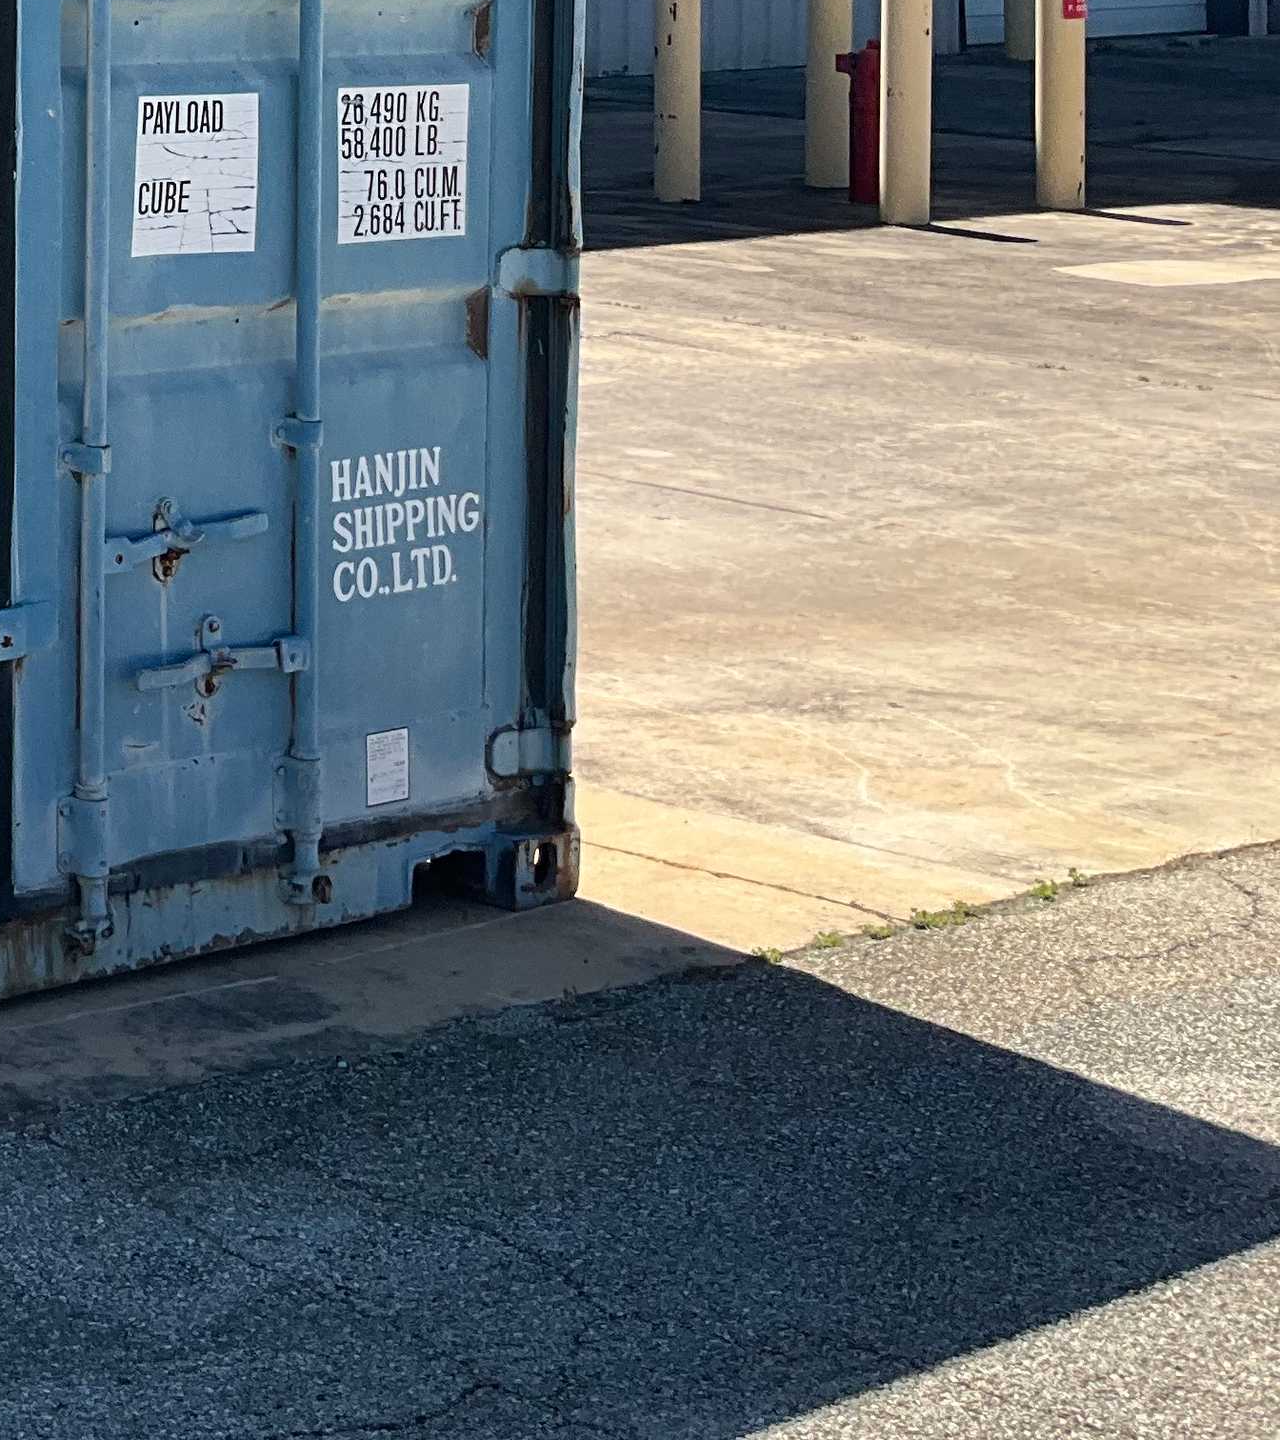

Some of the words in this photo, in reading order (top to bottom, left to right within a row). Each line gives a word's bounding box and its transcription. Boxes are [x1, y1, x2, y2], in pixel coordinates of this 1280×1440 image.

[141, 100, 224, 134] PAYLOAD
[416, 91, 444, 122] KG.
[341, 125, 406, 159] 58,400
[415, 124, 443, 156] LB.
[138, 179, 191, 216] CUBE
[364, 168, 406, 201] 76.0
[354, 202, 406, 236] 2,684
[330, 446, 442, 503] HANJIN
[331, 491, 481, 553] SHIPPING
